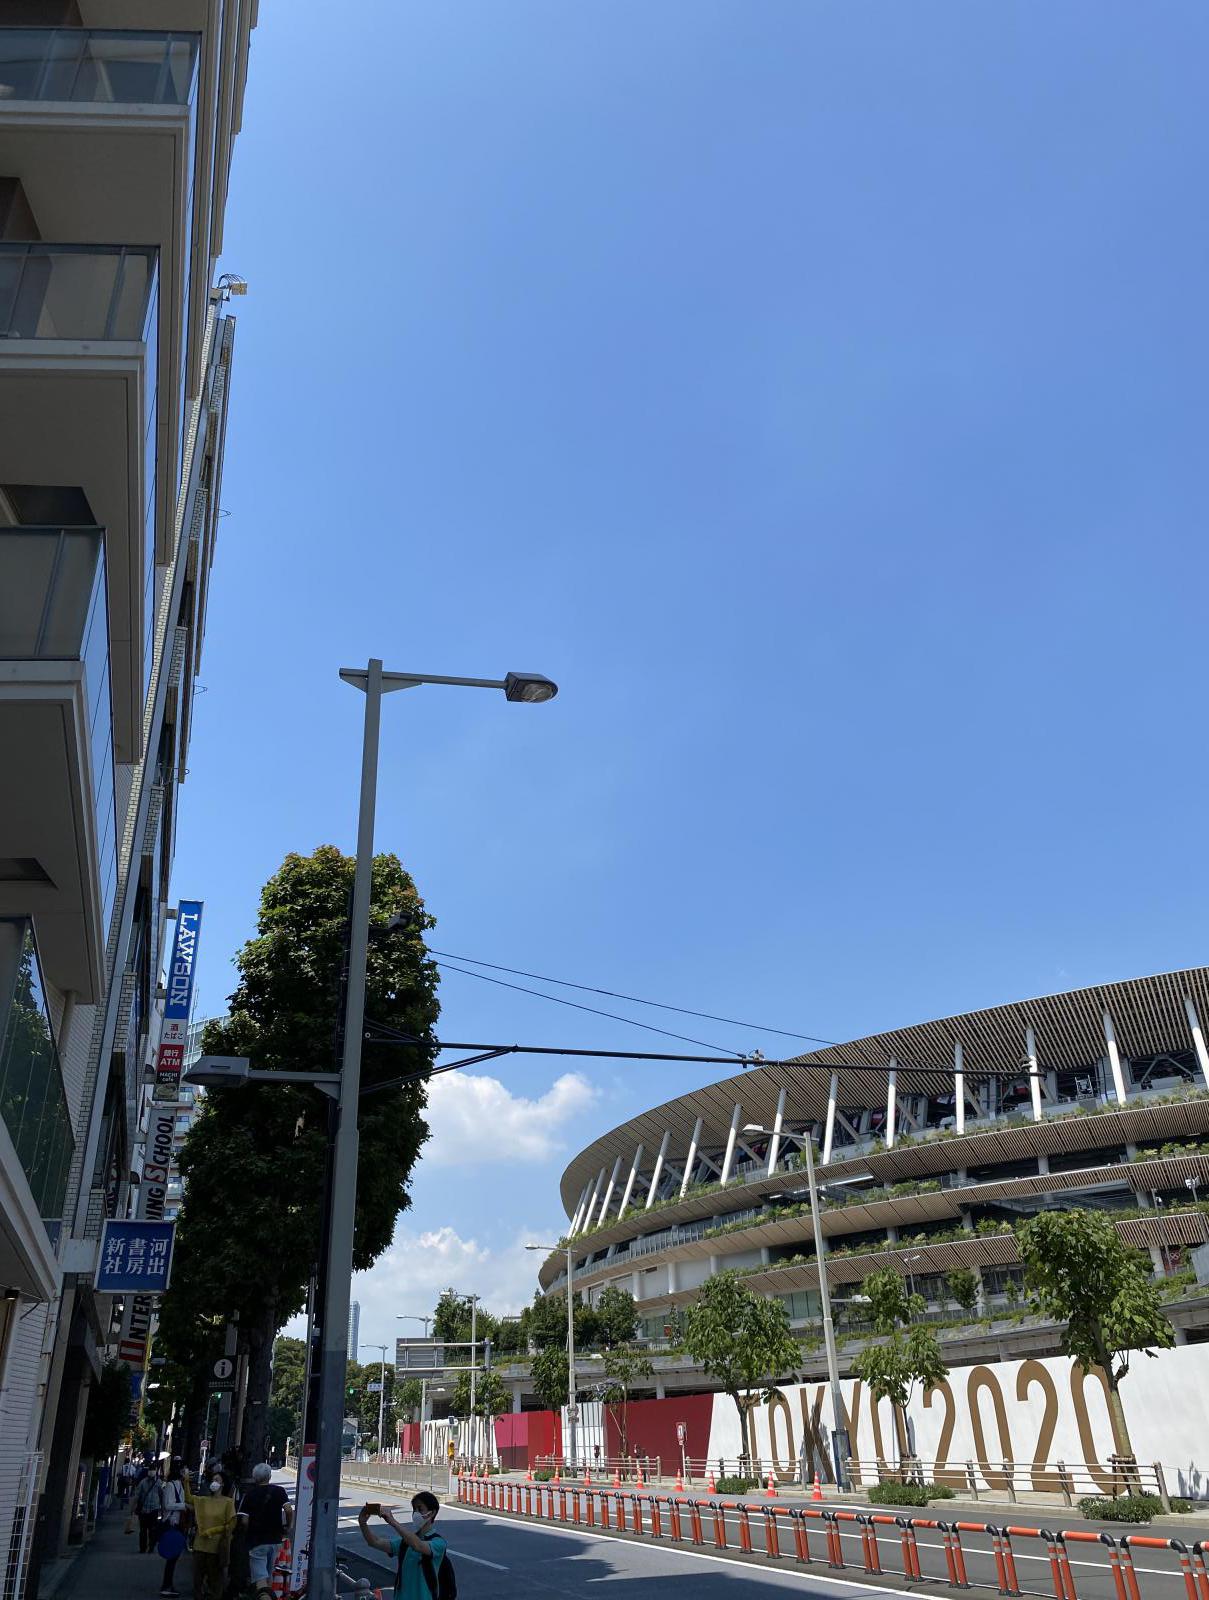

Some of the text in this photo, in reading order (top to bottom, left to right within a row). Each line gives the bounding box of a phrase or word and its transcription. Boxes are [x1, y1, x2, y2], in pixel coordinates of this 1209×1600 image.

[170, 912, 199, 1007] LAWSON
[163, 1031, 184, 1040] たばこ
[163, 1049, 179, 1057] 銀行
[159, 1057, 181, 1066] ATM
[144, 1116, 174, 1184] SCHOOL
[737, 1359, 1131, 1495] TOKYO 2020
